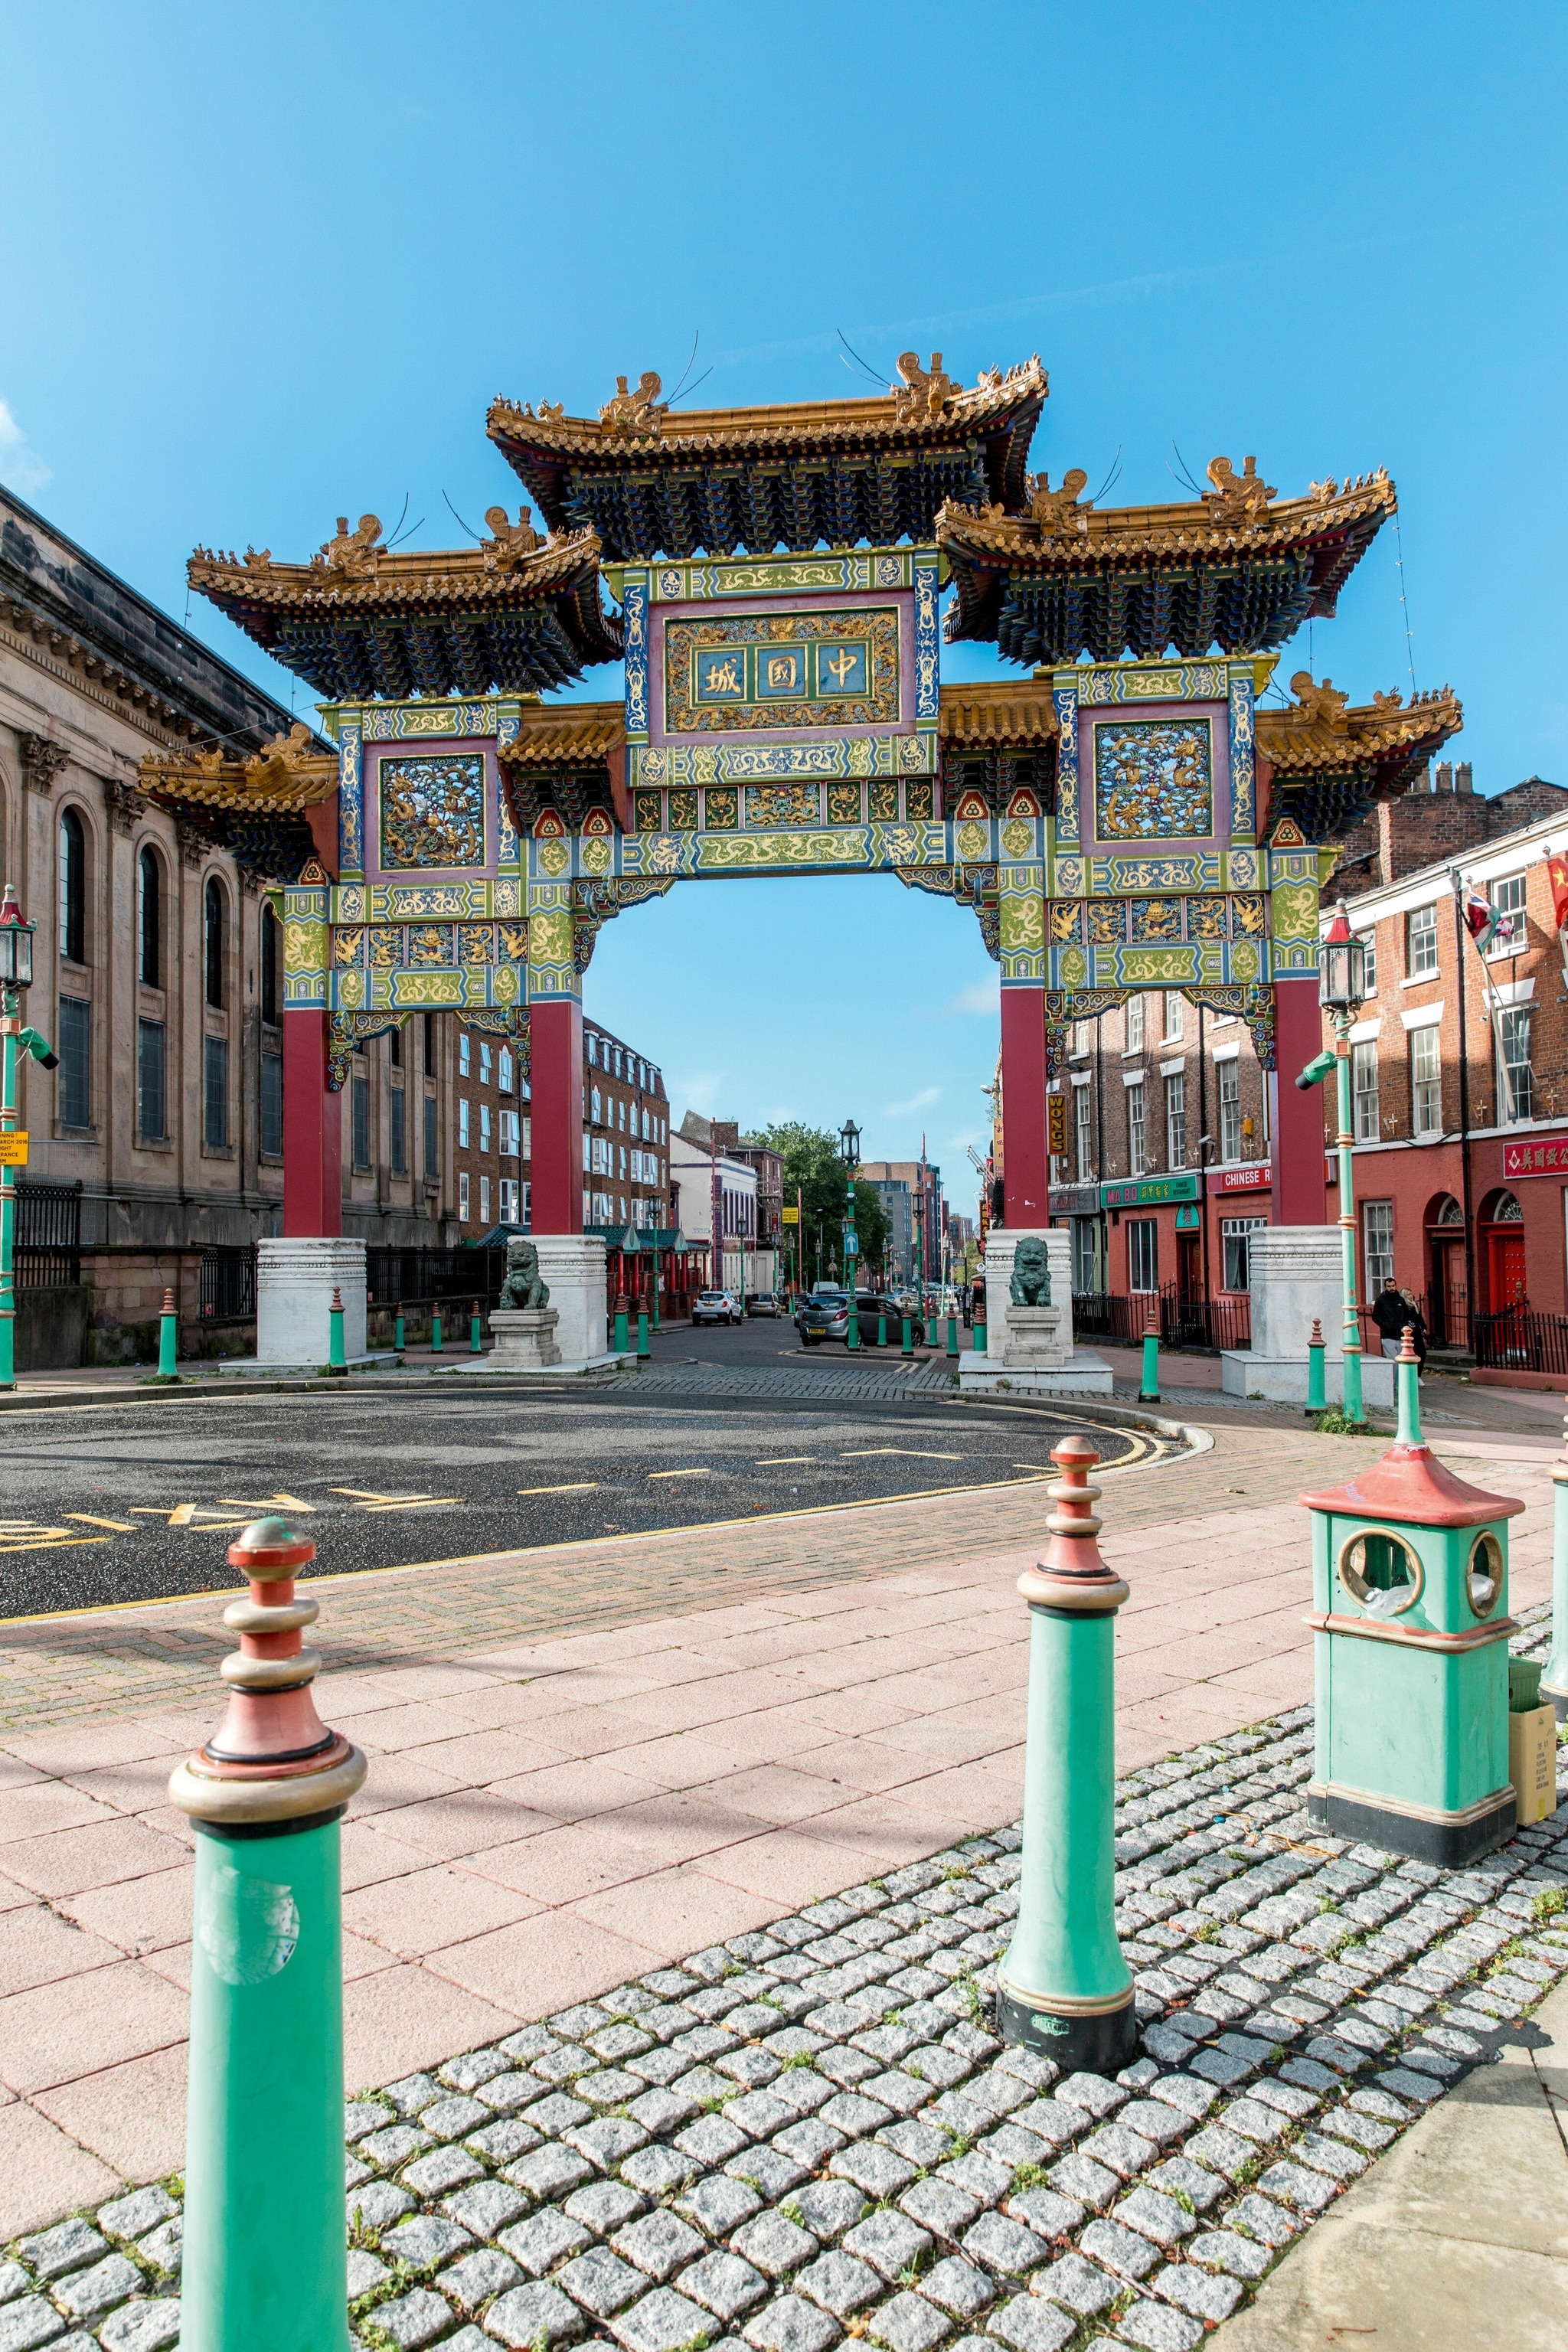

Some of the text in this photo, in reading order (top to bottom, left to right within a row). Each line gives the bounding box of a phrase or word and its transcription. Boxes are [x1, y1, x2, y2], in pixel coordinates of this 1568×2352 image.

[1048, 1096, 1063, 1151] WONGS
[1225, 1168, 1272, 1186] CHINESE R
[1107, 1188, 1121, 1204] MA
[1124, 1185, 1138, 1203] BO
